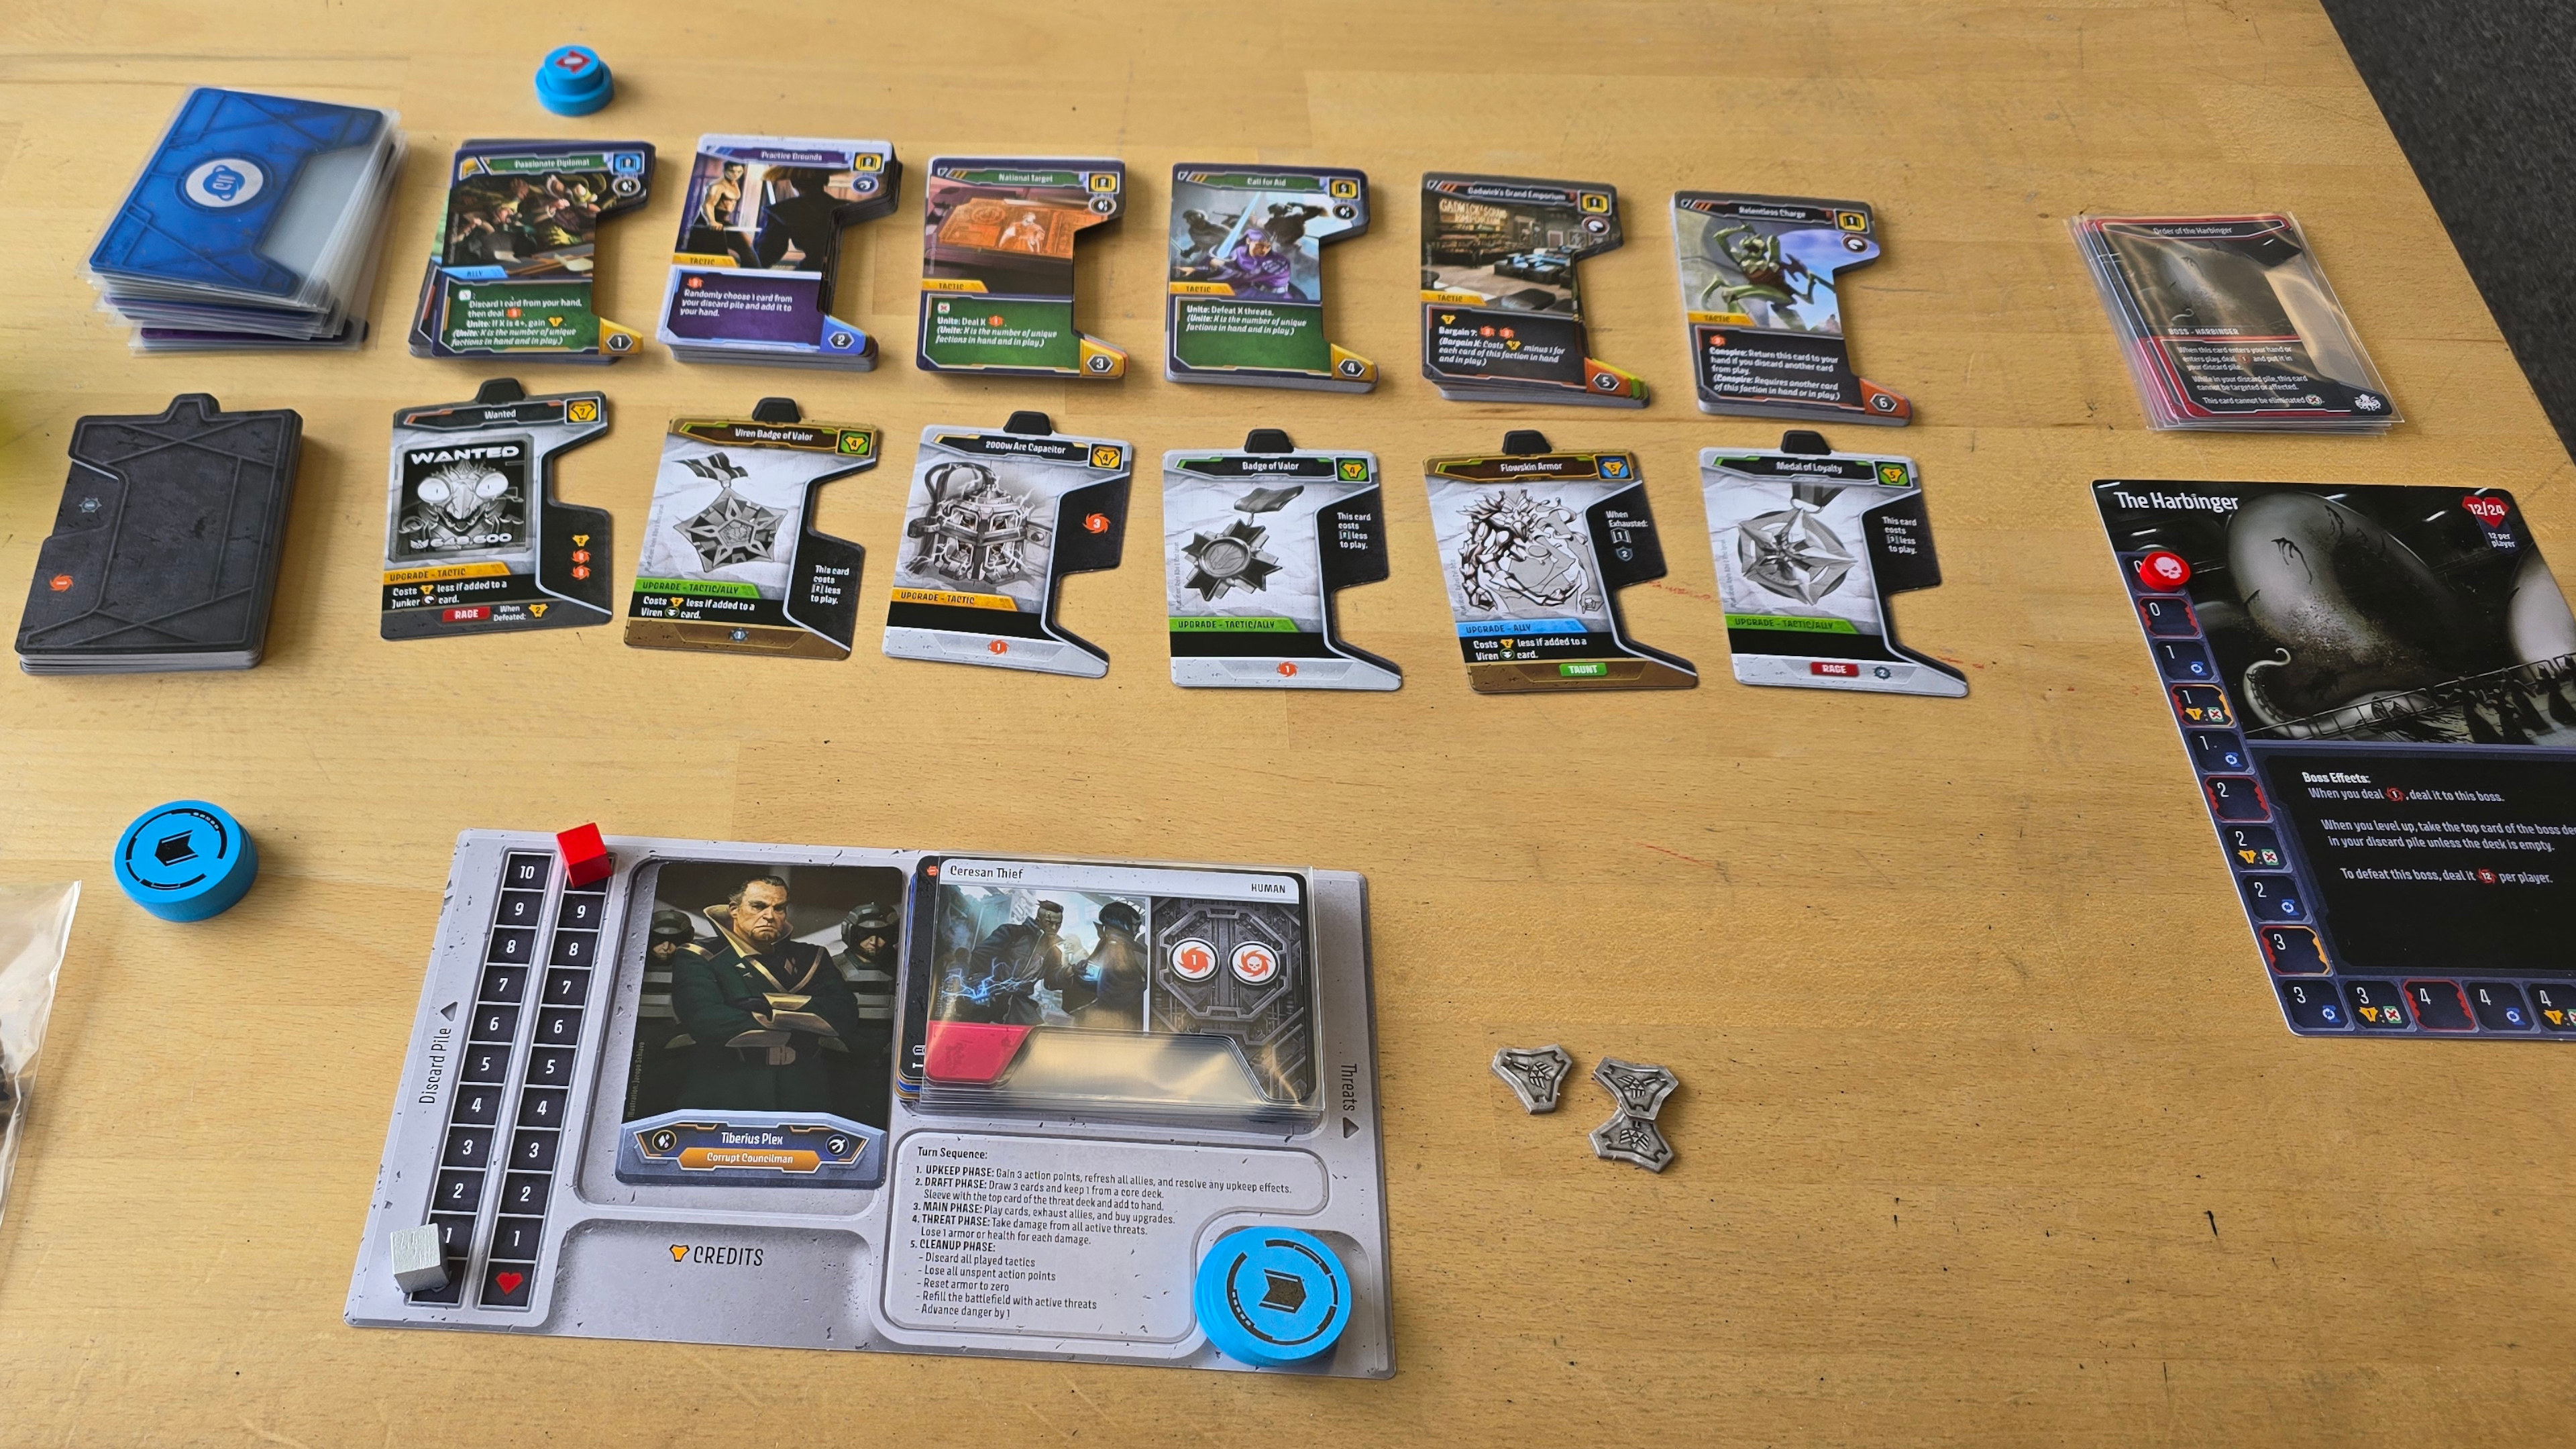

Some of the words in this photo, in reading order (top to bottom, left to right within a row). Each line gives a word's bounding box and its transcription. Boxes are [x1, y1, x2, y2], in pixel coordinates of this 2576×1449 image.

[515, 160, 555, 168] Passionate
[557, 158, 590, 168] Diplomat
[761, 152, 791, 160] Practice
[793, 152, 822, 160] Grounds
[999, 174, 1029, 182] National
[1031, 175, 1053, 183] Target
[1505, 189, 1526, 197] Grand
[1528, 191, 1566, 201] Emporium
[1739, 207, 1778, 215] Relentless
[1780, 209, 1805, 218] Charge
[2153, 227, 2174, 235] Order
[2196, 227, 2232, 235] Harbinger
[684, 290, 722, 300] Randomly
[775, 294, 792, 303] from
[1187, 305, 1210, 314] Unite:
[1244, 307, 1274, 316] threats.
[616, 337, 623, 347] 1
[837, 335, 845, 345] 2
[1097, 359, 1103, 368] 3
[1348, 363, 1355, 372] 4
[1603, 377, 1610, 386] 5
[1880, 398, 1887, 407] 6
[484, 410, 516, 419] Wanted
[735, 428, 755, 438] Viren
[757, 429, 782, 440] Badge
[783, 432, 790, 440] of
[792, 432, 813, 441] Valor
[985, 441, 1012, 450] 2000w
[1028, 444, 1066, 455] Capacitor
[411, 447, 519, 465] WANTED
[1242, 462, 1267, 470] Badge
[1278, 462, 1299, 470] Valor
[1501, 464, 1536, 472] Flowskin
[1538, 462, 1562, 471] Armor
[1776, 462, 1801, 471] Medal
[1803, 464, 1811, 472] of
[1813, 464, 1843, 474] Loyalty
[2113, 492, 2149, 508] The
[2150, 492, 2238, 513] Harbinger
[2467, 501, 2505, 516] 12/24
[1350, 541, 1368, 550] play.
[2491, 540, 2515, 548] player
[390, 572, 429, 581] UPGRADE
[437, 569, 466, 577] TACTIC
[393, 588, 417, 596] Costs
[437, 584, 455, 592] less
[456, 583, 462, 592] if
[464, 582, 489, 590] added
[392, 598, 420, 609] Junker
[439, 596, 460, 604] card.
[2149, 602, 2160, 616] 0
[455, 610, 478, 619] RAGE
[494, 613, 526, 621] Defeated:
[2165, 645, 2174, 659] 1
[1568, 665, 1597, 674] TAUNT
[1822, 665, 1847, 674] RAGE
[2182, 690, 2191, 704] 1
[2200, 736, 2207, 749] 1
[2302, 771, 2329, 783] Boss
[2330, 772, 2371, 784] Effects:
[2217, 782, 2229, 798] 2
[2308, 788, 2342, 798] When
[2341, 791, 2360, 800] you
[2361, 789, 2384, 799] deal
[2432, 790, 2442, 800] it
[2443, 791, 2454, 800] to
[2455, 791, 2476, 801] this
[2478, 792, 2505, 801] boss.
[2235, 831, 2247, 847] 2
[521, 865, 535, 879] 10
[951, 865, 994, 878] Ceresan
[996, 867, 1023, 880] Thief
[2340, 868, 2355, 879] To
[2356, 868, 2388, 879] defeat
[2390, 869, 2412, 880] this
[2415, 869, 2442, 881] boss,
[2443, 869, 2466, 880] deal
[2465, 871, 2475, 880] it
[2499, 873, 2516, 883] per
[2518, 872, 2553, 884] player.
[1251, 883, 1285, 894] HUMAN
[2255, 882, 2267, 898] 2
[515, 902, 525, 916] 9
[577, 905, 586, 918] 9
[506, 939, 516, 953] 8
[2273, 934, 2286, 950] 3
[569, 943, 578, 956] 8
[499, 978, 508, 991] 7
[562, 981, 571, 994] 7
[2294, 986, 2306, 1004] 3
[2357, 987, 2370, 1004] 3
[2420, 989, 2431, 1004] 4
[2480, 989, 2491, 1005] 4
[2540, 990, 2551, 1006] 4
[490, 1017, 499, 1031] 6
[554, 1020, 563, 1034] 6
[431, 1027, 451, 1052] Pile
[480, 1057, 490, 1071] 5
[546, 1059, 555, 1073] 5
[419, 1056, 445, 1104] Discard
[1340, 1064, 1357, 1112] Threats
[472, 1097, 482, 1112] 4
[537, 1101, 547, 1115] 4
[722, 1132, 759, 1144] Tiberius
[761, 1134, 783, 1145] Plex
[463, 1140, 472, 1155] 3
[529, 1142, 539, 1158] 3
[918, 1146, 937, 1157] Turn
[940, 1148, 987, 1159] Sequence:
[707, 1152, 740, 1163] Corrupt
[742, 1154, 793, 1164] Councilman
[453, 1183, 464, 1198] 2
[521, 1187, 531, 1201] 2
[914, 1203, 920, 1211] 3.
[923, 1202, 948, 1212] MAIN
[951, 1203, 982, 1213] PHASE:
[985, 1205, 1002, 1216] Play
[1005, 1207, 1030, 1217] cards,
[1033, 1208, 1067, 1218] exhaust
[1069, 1210, 1095, 1220] allies,
[1097, 1211, 1112, 1220] and
[1116, 1212, 1130, 1223] buy
[1133, 1214, 1175, 1224] upgrades.
[446, 1228, 452, 1242] 1
[514, 1231, 520, 1246] 1
[694, 1246, 763, 1266] CREDITS
